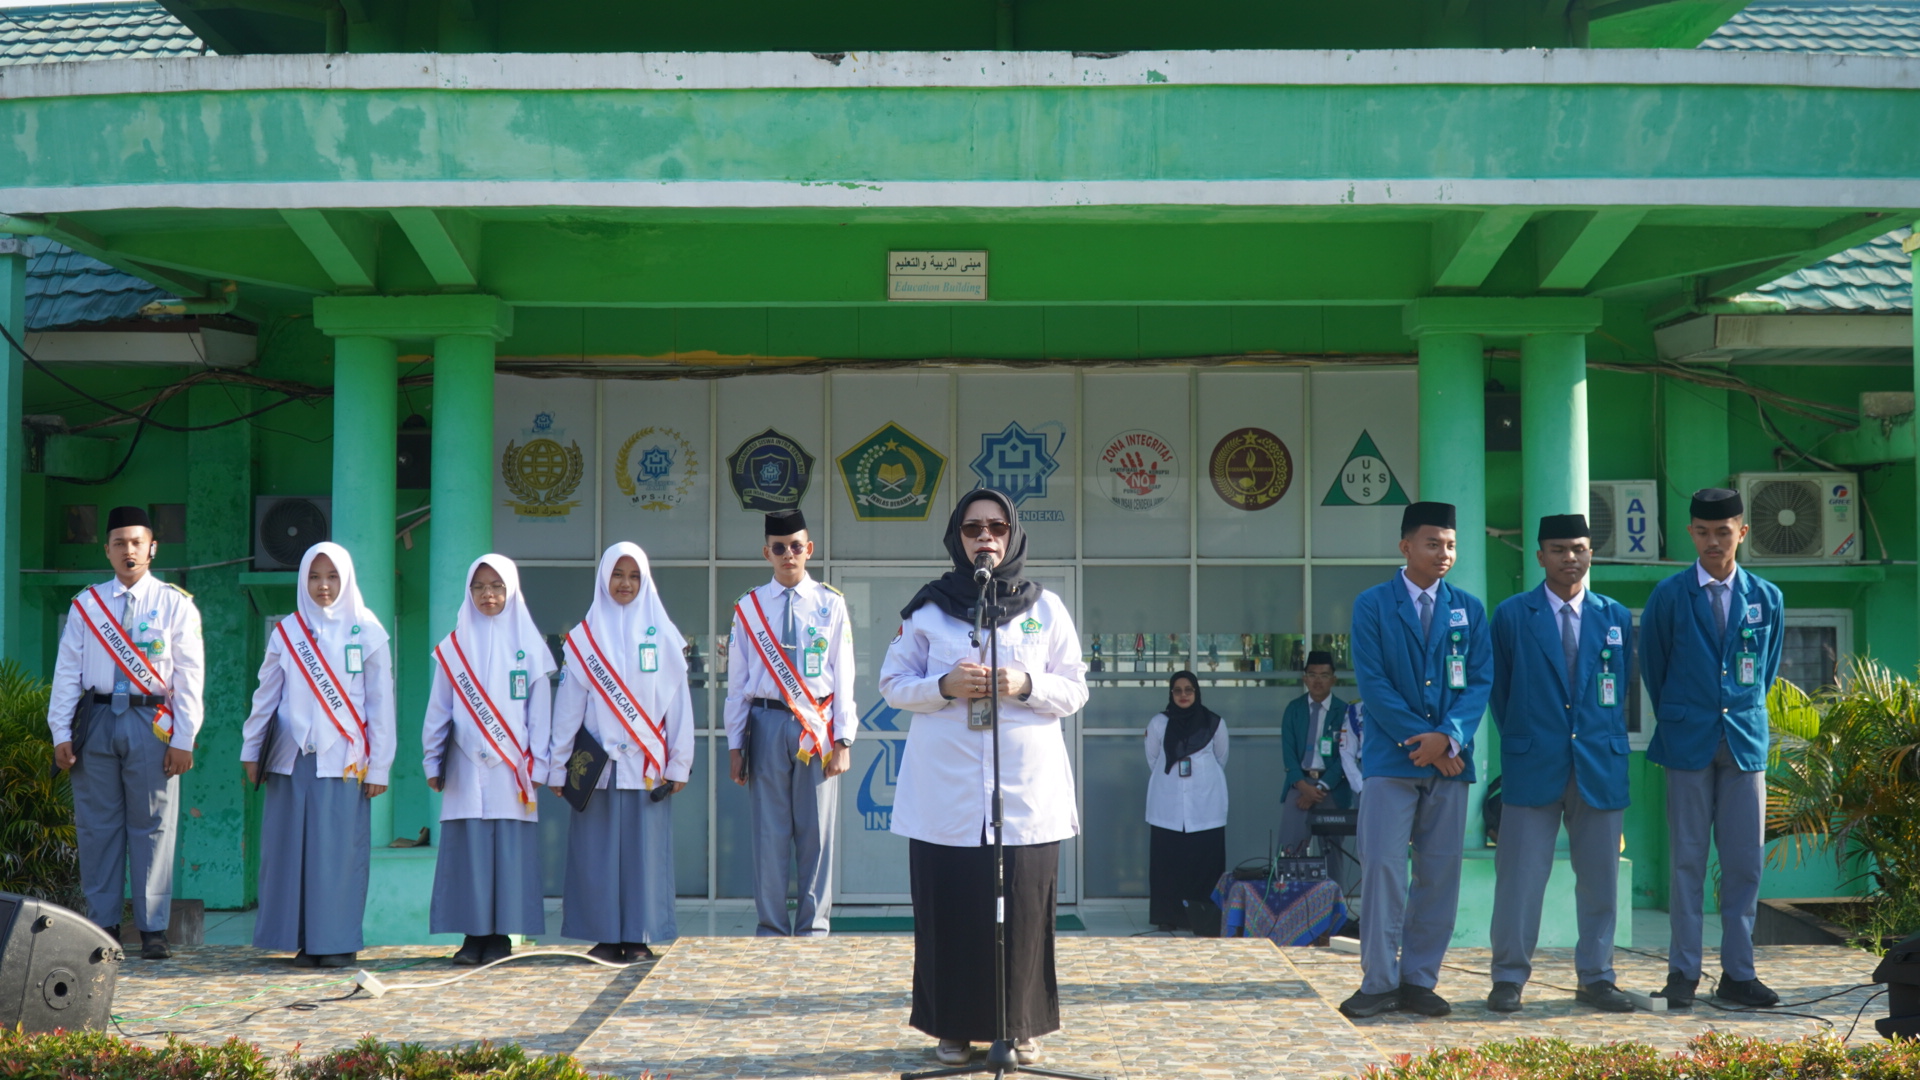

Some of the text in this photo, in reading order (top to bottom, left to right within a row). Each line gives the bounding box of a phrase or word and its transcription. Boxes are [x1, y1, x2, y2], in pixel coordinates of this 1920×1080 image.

[894, 281, 981, 295] Education Building
[757, 438, 775, 446] SISWA
[775, 438, 791, 449] INTRA
[1102, 433, 1174, 464] ZONA INTEGRITAS
[1131, 474, 1150, 488] NO
[870, 494, 915, 507] IKHLAS BERAMAL
[1016, 510, 1065, 521] ENDEKIA
[1626, 498, 1647, 553] AUX
[100, 622, 134, 668] PEMBACA
[132, 663, 154, 687] DO'A
[757, 630, 803, 700] AJUDAN PEMBINA
[296, 641, 343, 711] PEMBACA IKRAR
[586, 654, 639, 723] PEMBAWA ACARA
[456, 672, 506, 742] PEMBACA UUD 1945
[865, 811, 892, 831] IN
